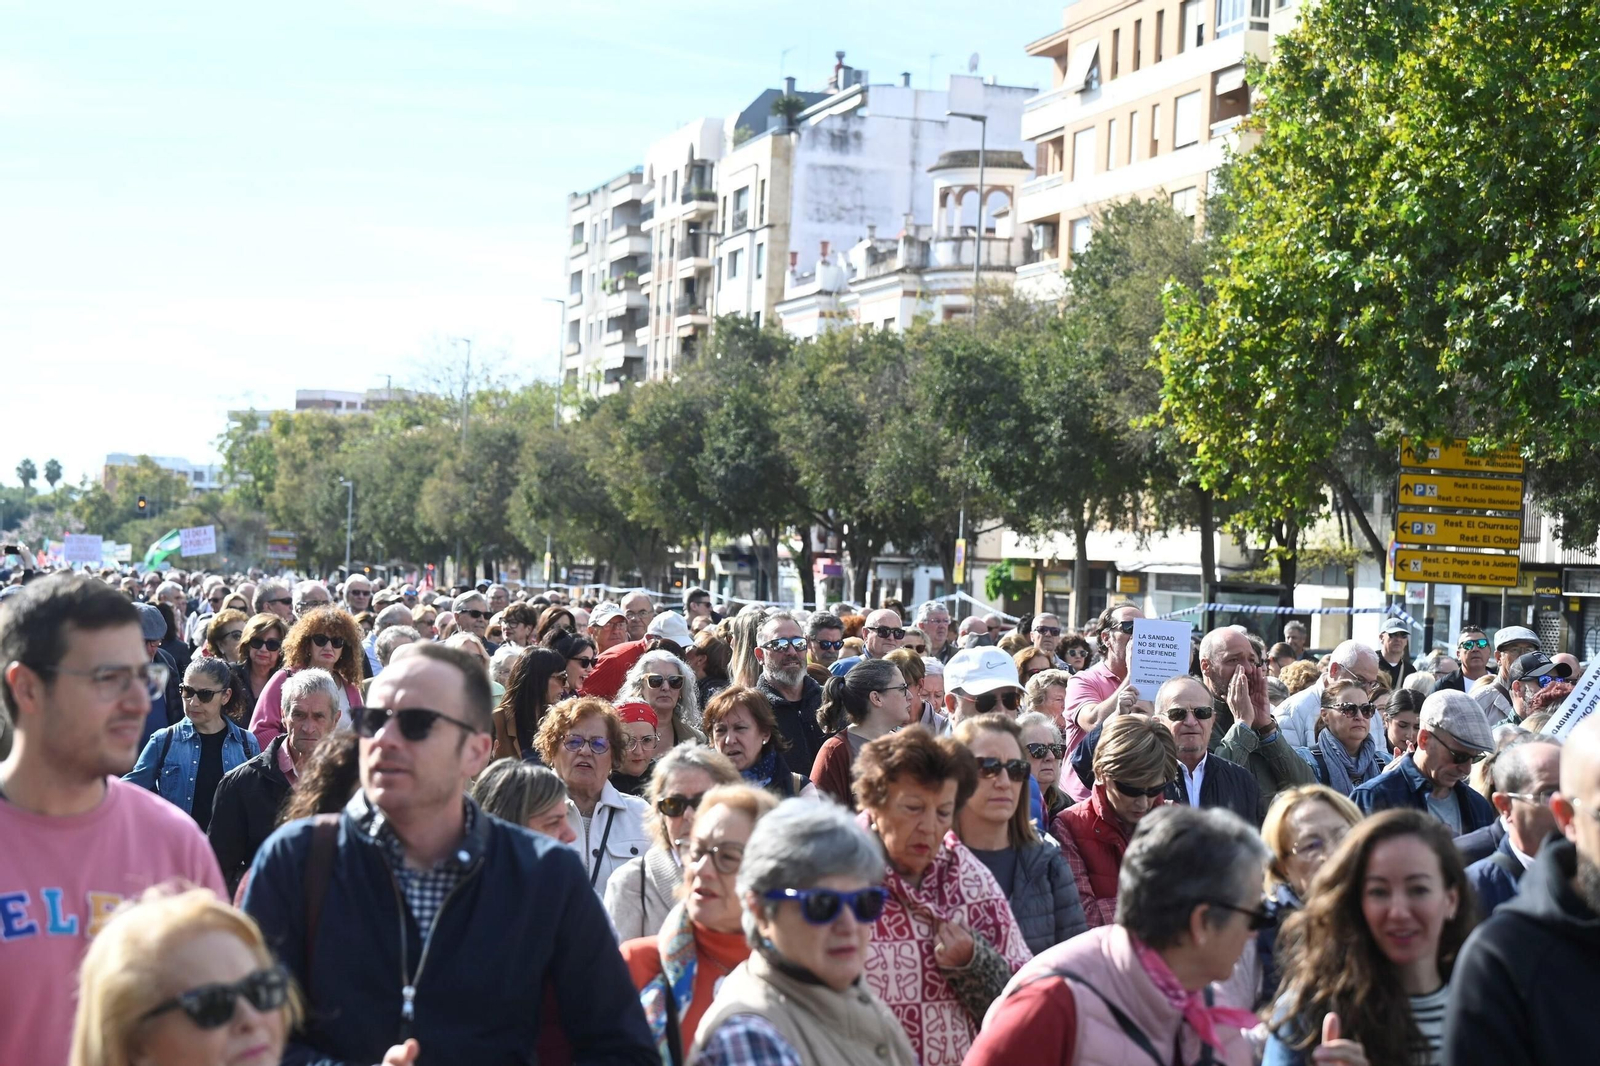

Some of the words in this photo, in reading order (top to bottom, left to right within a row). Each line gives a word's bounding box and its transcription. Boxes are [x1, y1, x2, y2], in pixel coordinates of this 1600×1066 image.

[1464, 459, 1482, 467] Rest.
[1479, 483, 1504, 491] Caballo
[1506, 484, 1521, 493] Rojo
[1463, 496, 1486, 504] Palacio
[1487, 497, 1520, 506] Bandolero
[1443, 519, 1464, 528] Rest.
[1466, 520, 1475, 529] El
[1477, 521, 1519, 531] Churrasco
[1460, 534, 1480, 543] Rest.
[1482, 534, 1491, 543] El
[1493, 535, 1518, 545] Choto
[1422, 556, 1440, 564] Rest.
[1442, 556, 1450, 564] C.
[1452, 557, 1470, 567] Pepe
[1471, 558, 1480, 566] de
[1482, 558, 1490, 567] la
[1422, 570, 1440, 578] Rest.
[1443, 571, 1450, 579] El
[1453, 571, 1476, 580] Rincón
[1477, 573, 1487, 581] de
[1488, 573, 1516, 582] Carmen
[1147, 634, 1175, 642] SANIDAD
[1146, 649, 1177, 657] DEFIENDE
